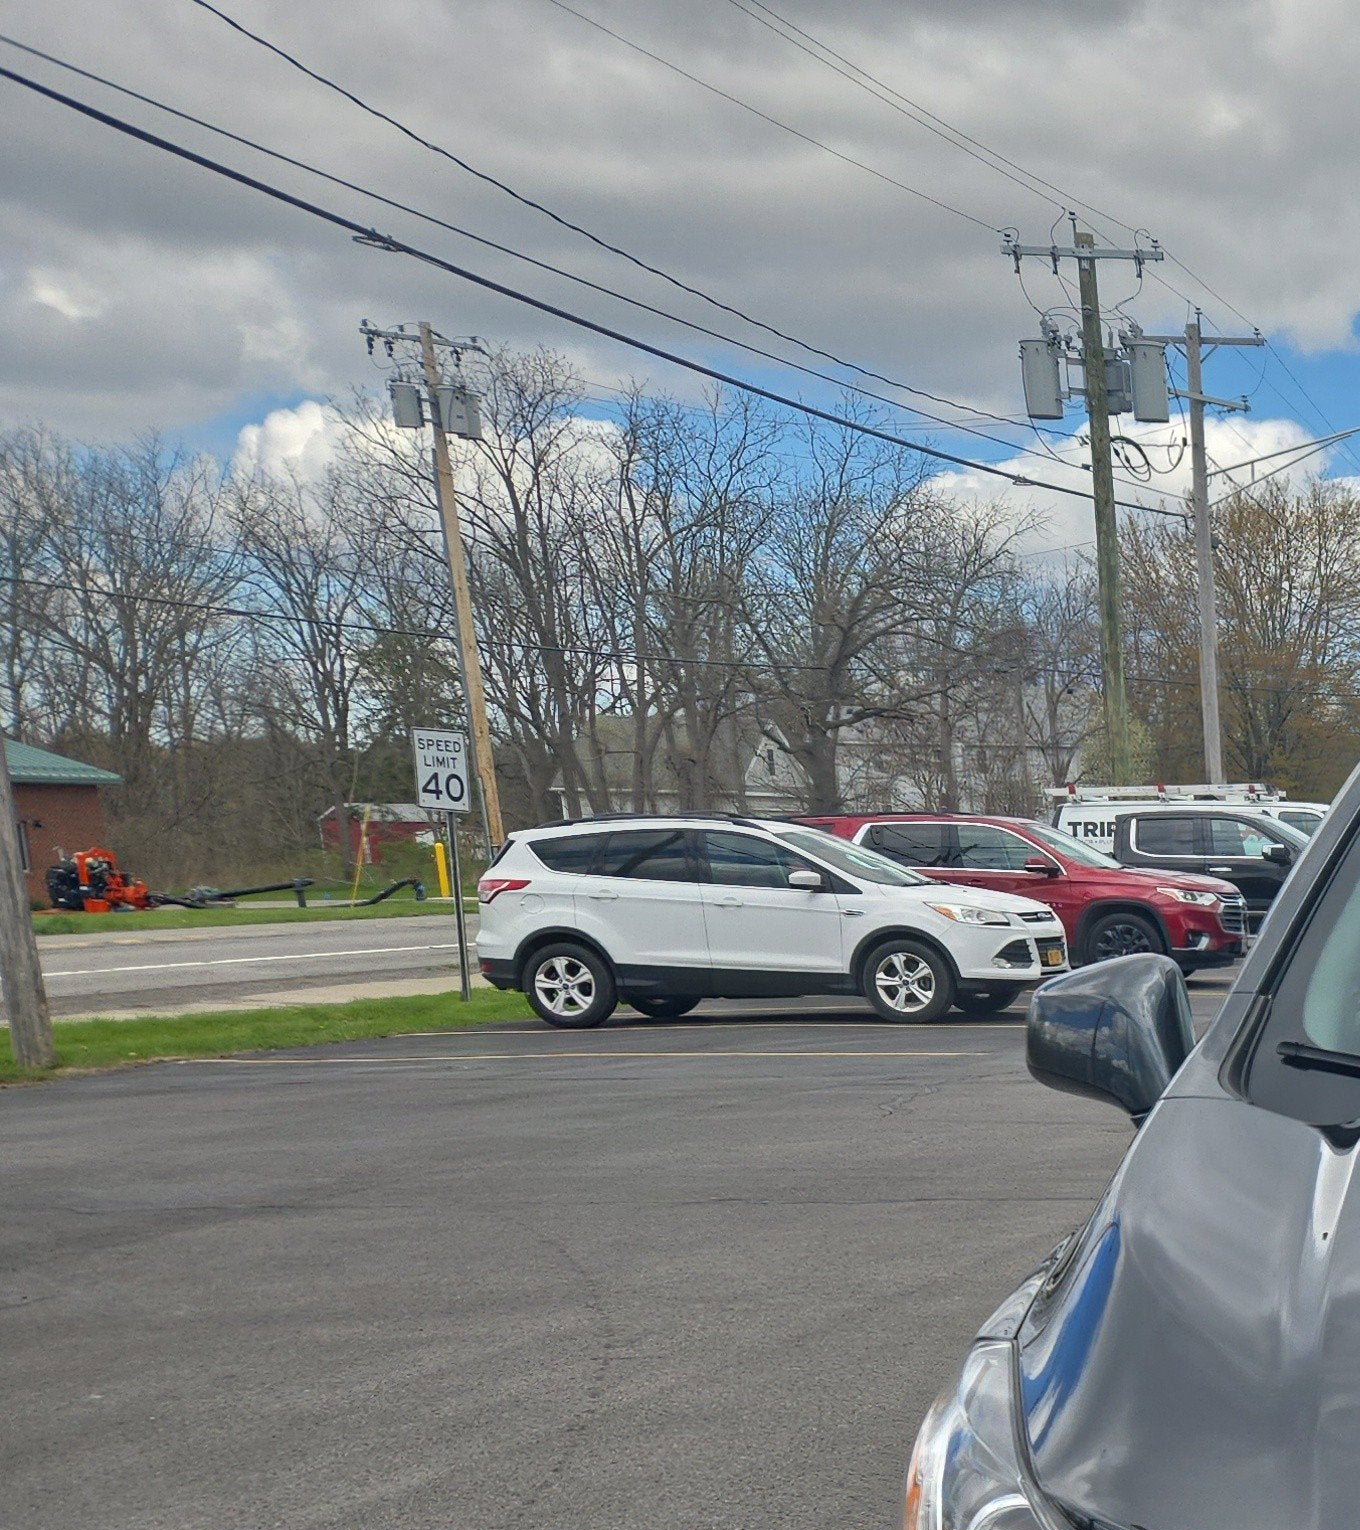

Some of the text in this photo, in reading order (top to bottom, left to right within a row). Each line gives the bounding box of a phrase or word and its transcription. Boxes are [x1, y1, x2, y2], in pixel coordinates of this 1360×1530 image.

[417, 738, 462, 753] SPEED
[423, 755, 458, 769] LIMIT
[422, 772, 465, 802] 40
